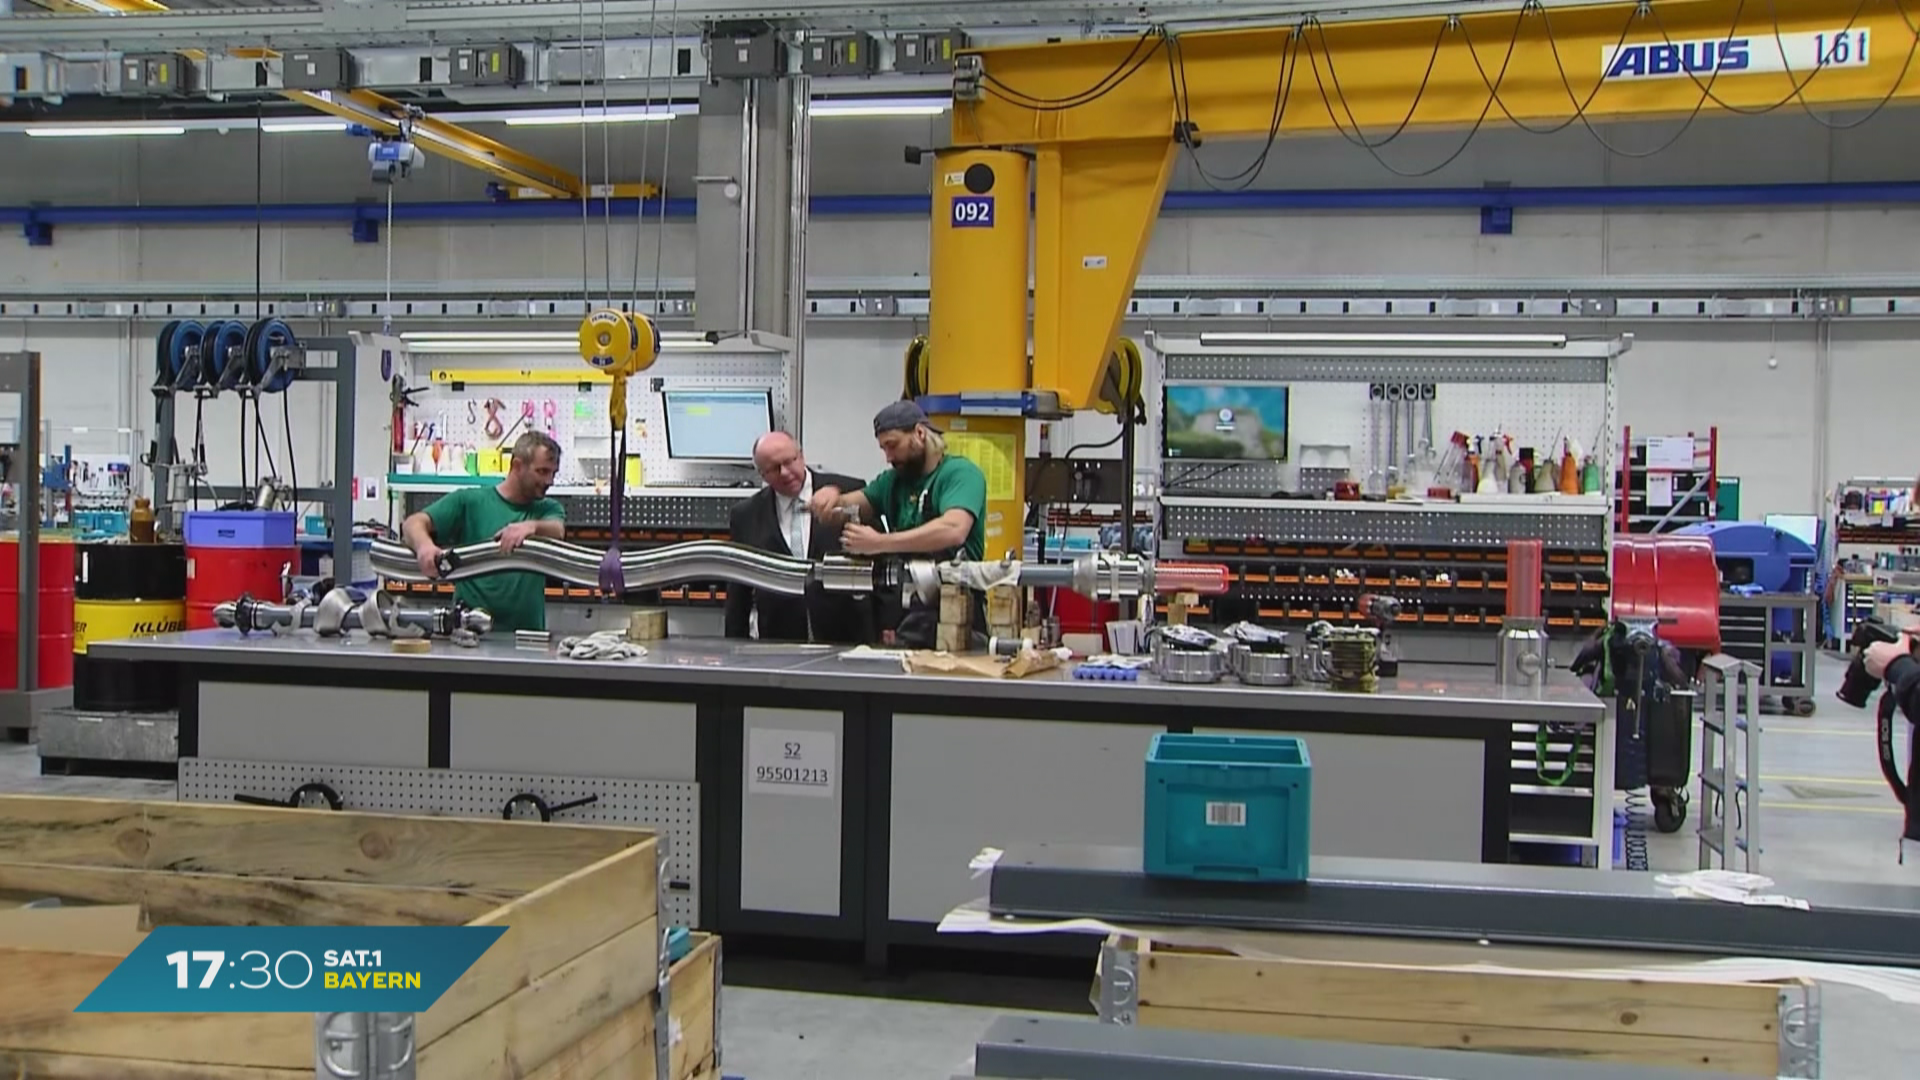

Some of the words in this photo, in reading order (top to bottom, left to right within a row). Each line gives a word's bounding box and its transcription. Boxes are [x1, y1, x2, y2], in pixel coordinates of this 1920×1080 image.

[1607, 39, 1749, 78] ABUS
[1858, 31, 1867, 62] t
[955, 202, 989, 221] 092
[784, 742, 801, 757] S2
[757, 766, 828, 784] 95501213
